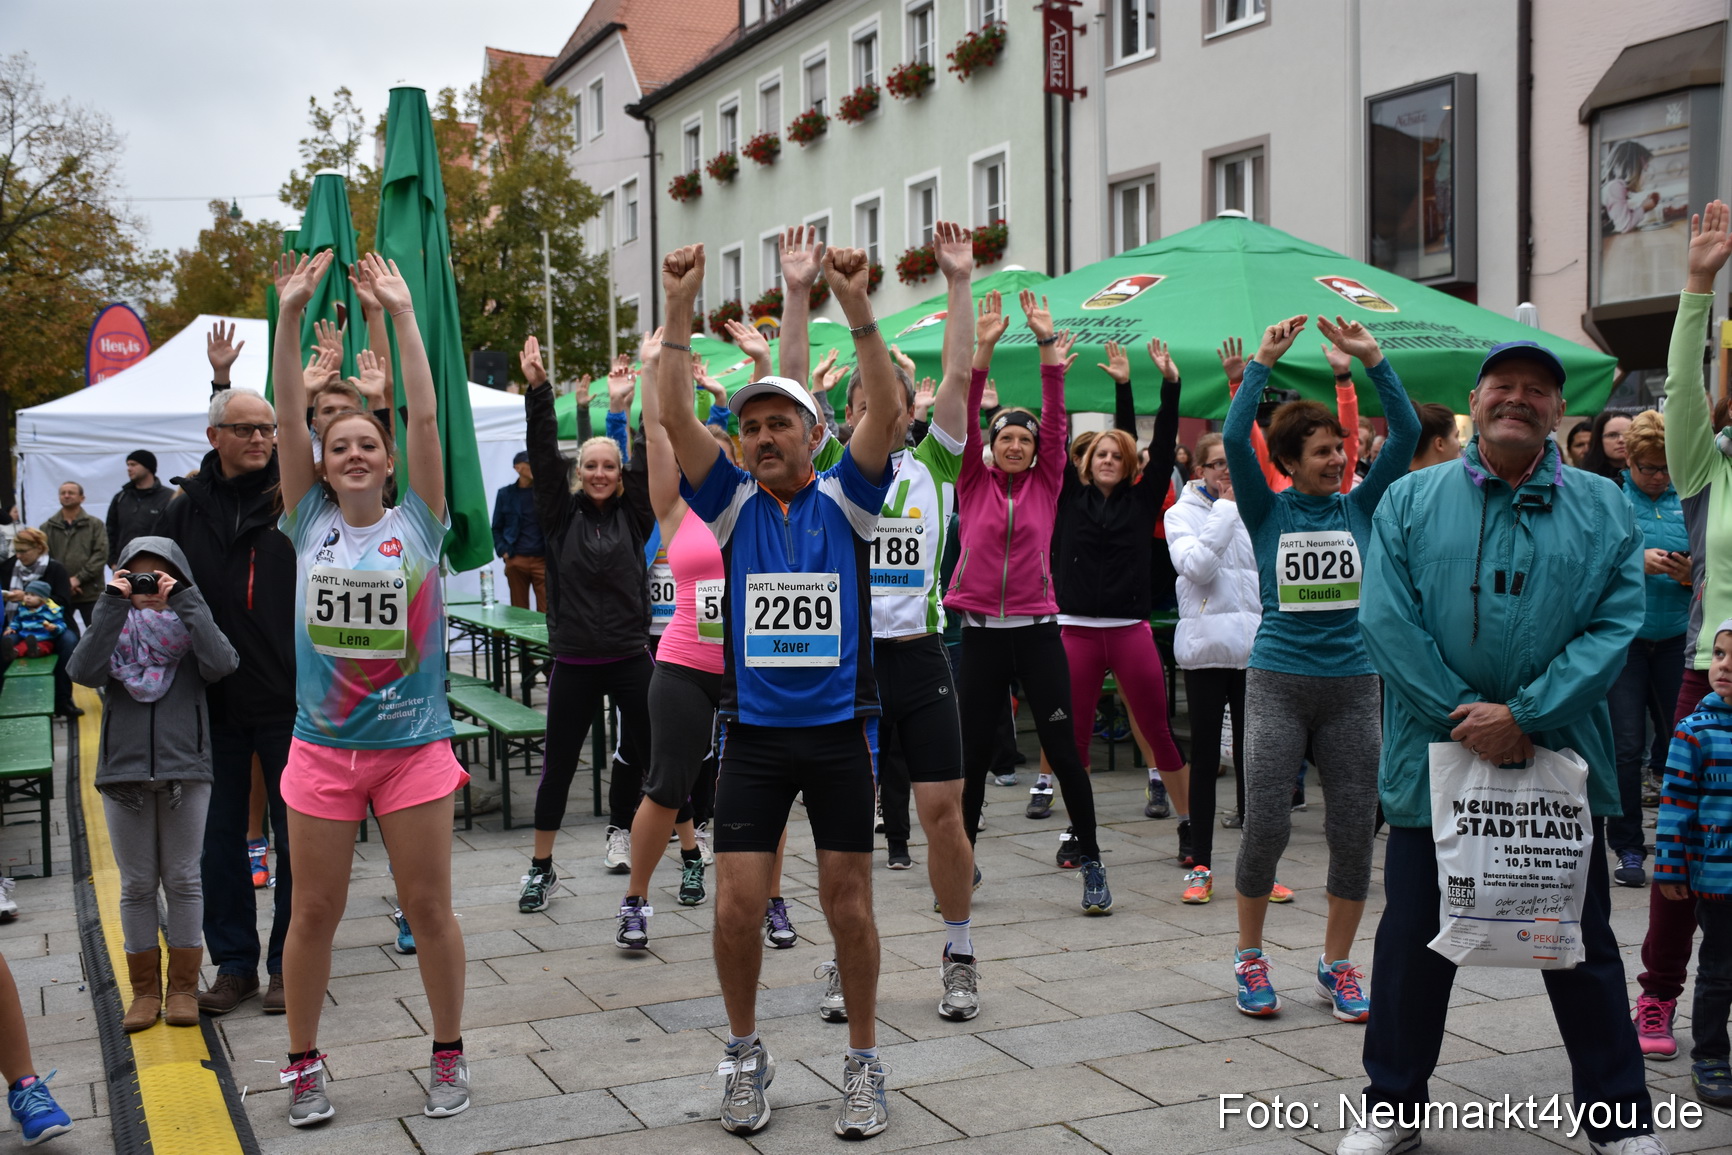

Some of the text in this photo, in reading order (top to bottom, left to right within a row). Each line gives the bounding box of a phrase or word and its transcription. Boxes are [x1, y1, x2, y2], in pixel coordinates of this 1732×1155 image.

[1049, 20, 1067, 88] Achatz
[100, 337, 141, 355] Hervis
[870, 536, 920, 566] 188
[1280, 539, 1344, 549] PARTL Neumarkt
[1286, 550, 1354, 581] 5028
[311, 574, 390, 589] PARTL Neumarkt
[869, 572, 909, 584] einhard
[650, 582, 675, 602] 30
[697, 585, 722, 593] PARTL
[748, 582, 824, 592] PARTL Neumarkt
[1299, 588, 1341, 600] Claudia
[316, 589, 398, 625] 5115
[755, 595, 833, 630] 2269
[339, 632, 370, 646] Lena
[773, 639, 810, 653] Xaver
[379, 686, 402, 701] 16.
[378, 697, 425, 711] Neumarkter
[377, 707, 417, 721] Stadtlauf
[1453, 797, 1583, 818] Neumarkter
[1504, 844, 1583, 858] Halbmarathon
[1505, 858, 1577, 870] 10,5 km Lauf
[1448, 875, 1476, 888] DKMS
[1483, 872, 1527, 880] Unterstützen
[1448, 887, 1474, 898] LEBEN
[1495, 897, 1517, 907] Oder
[1521, 895, 1547, 906] wollen
[1496, 907, 1511, 916] der
[1515, 905, 1539, 916] Stelle
